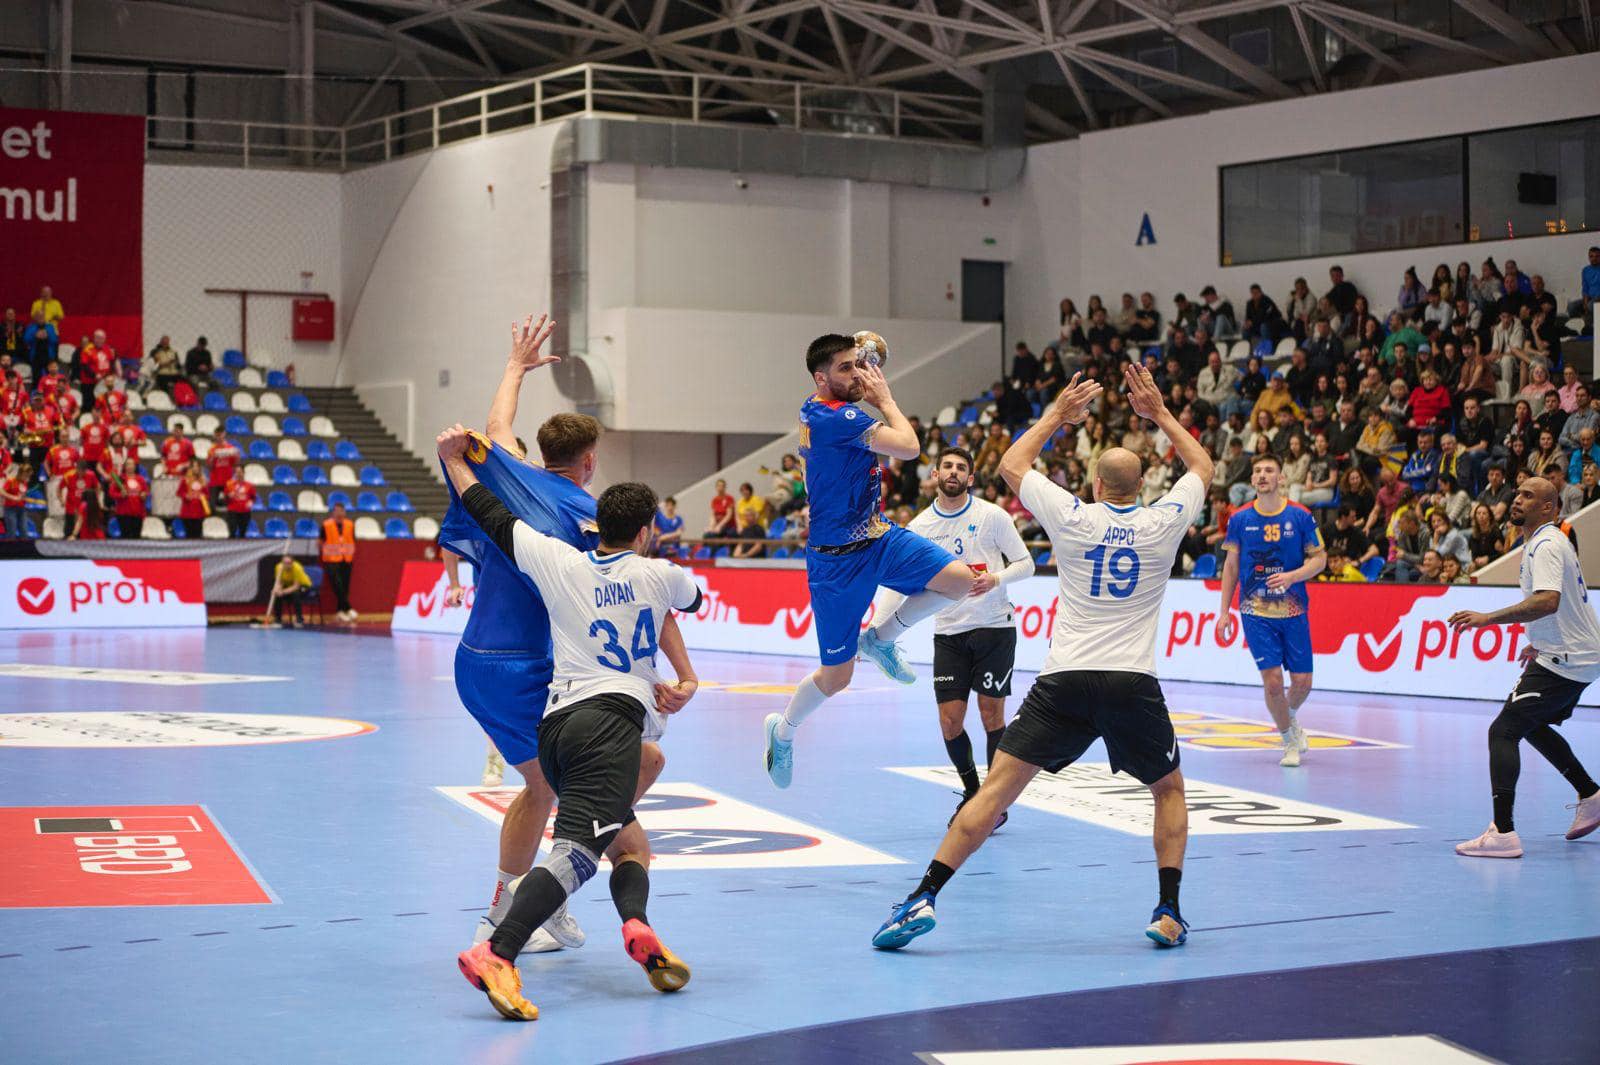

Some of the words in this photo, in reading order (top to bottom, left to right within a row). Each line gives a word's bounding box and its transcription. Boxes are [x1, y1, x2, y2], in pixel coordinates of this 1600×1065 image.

[1135, 212, 1158, 247] A
[954, 537, 964, 555] 3
[1102, 525, 1135, 546] APPO
[1263, 523, 1280, 542] 35
[1084, 544, 1140, 598] 19
[594, 580, 636, 609] DAYAN
[588, 606, 659, 675] 34
[982, 671, 994, 689] 3
[73, 835, 193, 875] BRD
